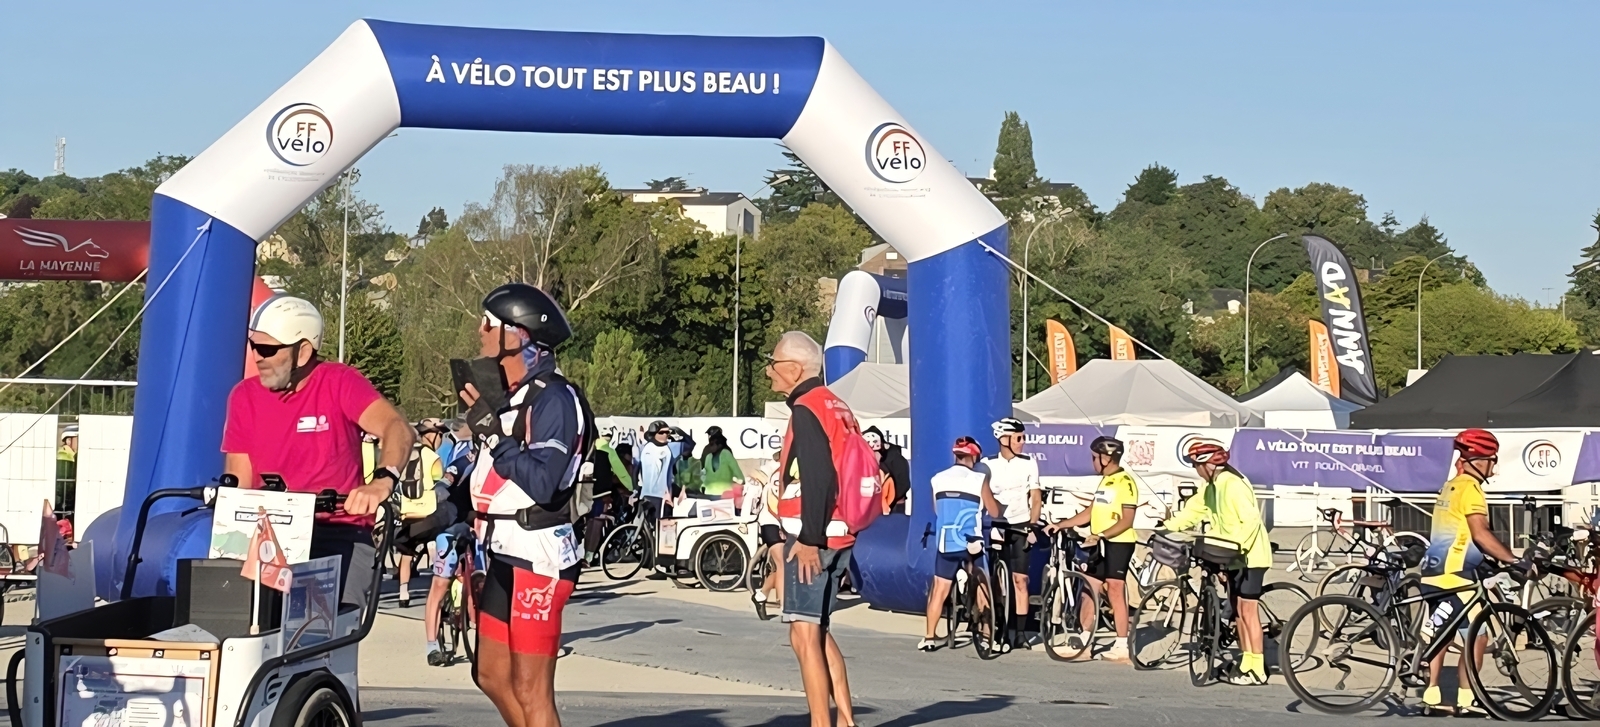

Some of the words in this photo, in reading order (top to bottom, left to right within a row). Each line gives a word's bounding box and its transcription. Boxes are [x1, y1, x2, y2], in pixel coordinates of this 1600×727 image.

[425, 54, 446, 83] À
[451, 57, 516, 87] VÉLO
[522, 65, 587, 90] TOUT
[593, 67, 633, 91] EST
[638, 70, 696, 93] PLUS
[703, 71, 766, 95] BEAU
[772, 73, 781, 94] !
[296, 122, 317, 137] FF
[277, 134, 324, 153] vélo
[893, 141, 910, 154] FF
[877, 153, 921, 170] vélo
[20, 260, 35, 270] LA
[40, 260, 101, 272] MAYENNE
[1321, 261, 1365, 375] ANNAD
[1300, 443, 1331, 453] TOUT
[1332, 443, 1354, 454] EST
[1291, 461, 1309, 469] VTT
